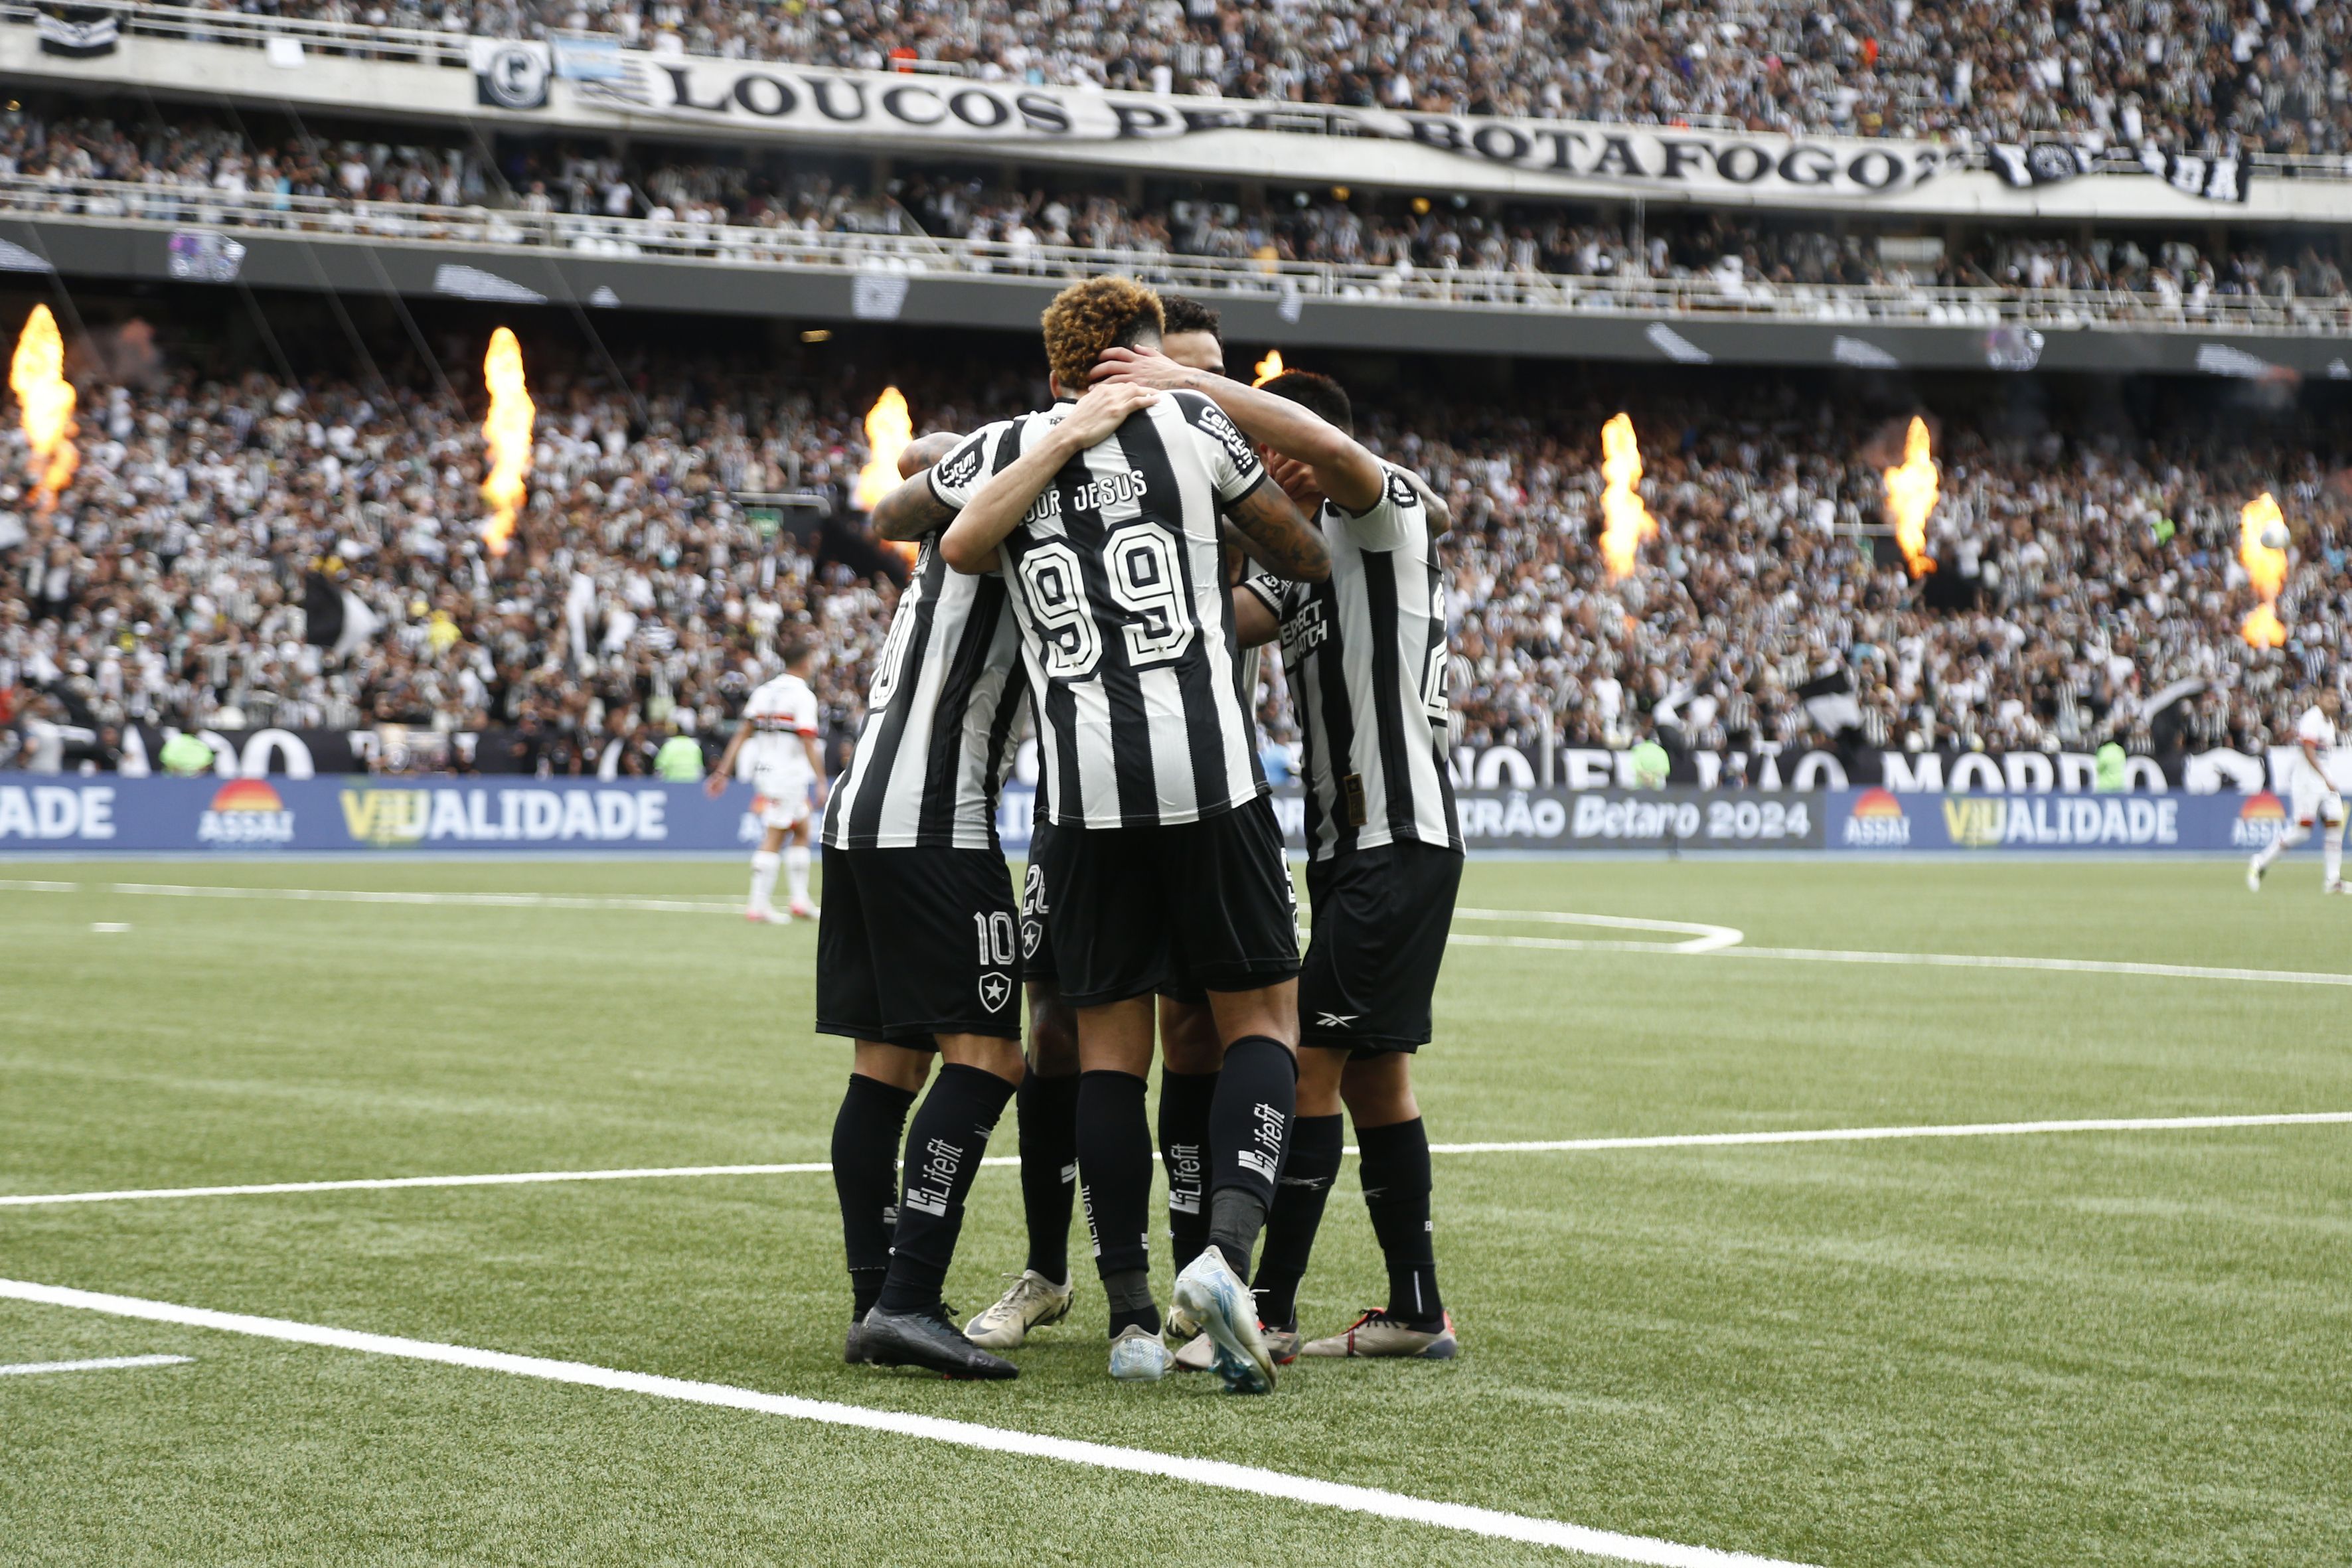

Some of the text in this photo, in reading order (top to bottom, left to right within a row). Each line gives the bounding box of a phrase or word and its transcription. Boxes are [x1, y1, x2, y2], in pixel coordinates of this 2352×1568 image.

[659, 66, 1070, 133] LOUCOS
[1409, 117, 1905, 191] BOTAFOGO
[1073, 469, 1148, 512] JESUS
[1018, 520, 1194, 678] 99
[1705, 800, 1812, 839] 2024
[973, 911, 1016, 965] 10
[1253, 1103, 1286, 1170] Lifefit
[921, 1138, 964, 1199] Lifefit
